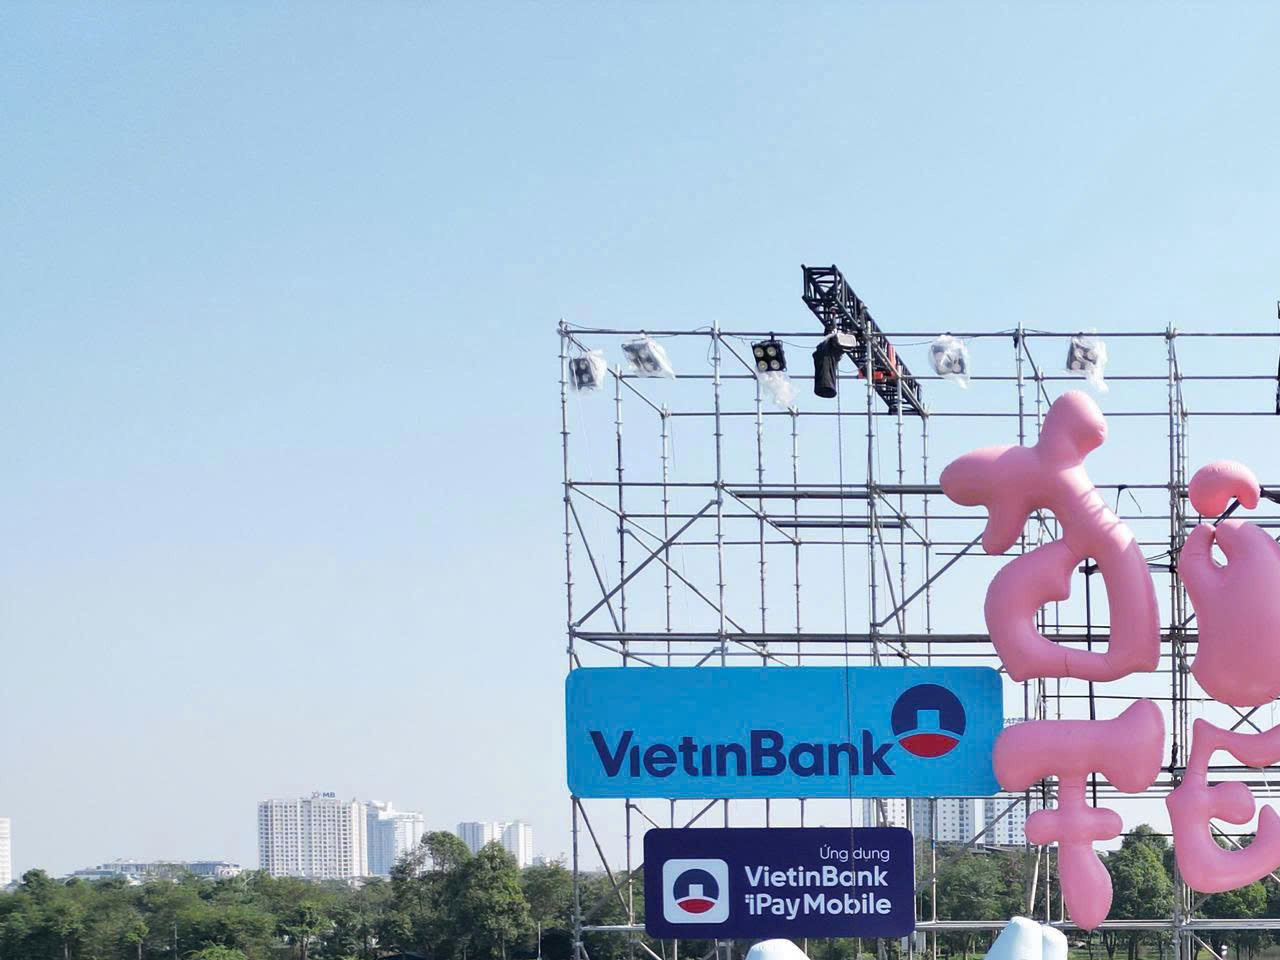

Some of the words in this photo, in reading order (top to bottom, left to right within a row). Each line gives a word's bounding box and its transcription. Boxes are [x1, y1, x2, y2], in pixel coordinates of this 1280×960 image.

[589, 730, 895, 777] VietinBank
[819, 843, 849, 863] Ứng
[852, 847, 890, 863] dụng
[744, 865, 889, 887] VietinBank
[744, 893, 801, 920] iPay
[803, 892, 892, 915] Mobile
